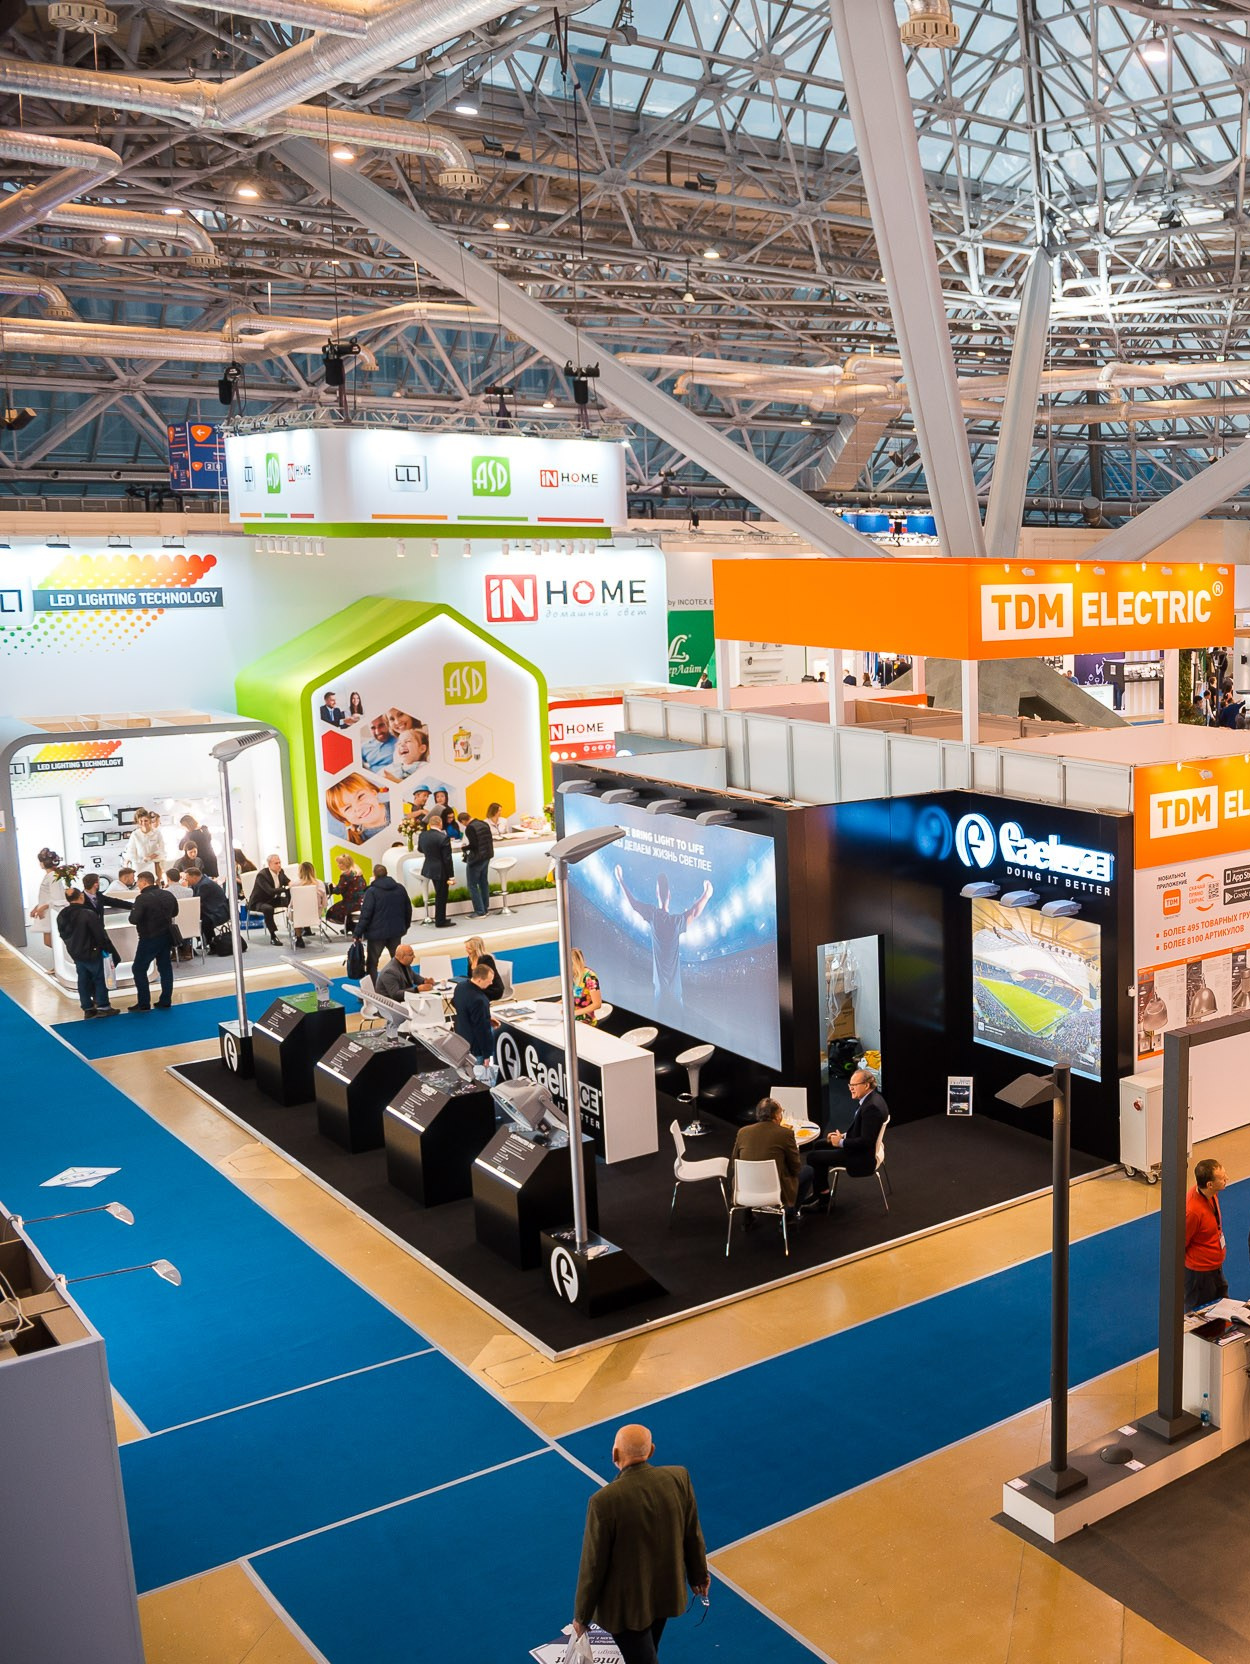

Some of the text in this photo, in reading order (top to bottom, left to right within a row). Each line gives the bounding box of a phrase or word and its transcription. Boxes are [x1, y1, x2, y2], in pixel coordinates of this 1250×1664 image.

[473, 459, 508, 492] ASD
[561, 472, 599, 484] HOME
[50, 591, 218, 607] LED LIGHTING TECHNOLOGY
[546, 580, 647, 605] HOME
[677, 598, 707, 606] INCOTEX
[545, 609, 648, 618] домашний свет
[991, 593, 1064, 631] TDM
[446, 666, 483, 700] ASD
[566, 722, 604, 735] HOME
[37, 758, 122, 771] LED LIGHTING TECHNOLOGY
[1158, 794, 1211, 829] TDM
[631, 828, 653, 841] BRING
[653, 833, 675, 848] LIGHT
[676, 839, 686, 851] TO
[687, 842, 705, 855] LIFE
[652, 846, 678, 863] ЖИЗНЬ
[678, 853, 713, 872] СВЕТЛЕЕ
[1006, 866, 1111, 897] DOING IT BETTER
[1156, 879, 1188, 890] ПРИЛОЖЕНИЕ
[1157, 872, 1187, 882] МОБИЛЬНОЕ
[1232, 873, 1243, 882] App
[1166, 898, 1178, 907] TDM
[1163, 925, 1186, 938] БОЛЕЕ
[1187, 922, 1200, 932] 495
[1201, 913, 1238, 929] ТОВАРНЫХ
[1163, 924, 1245, 951] БОЛЕЕ 8100 АРТИКУЛОВ
